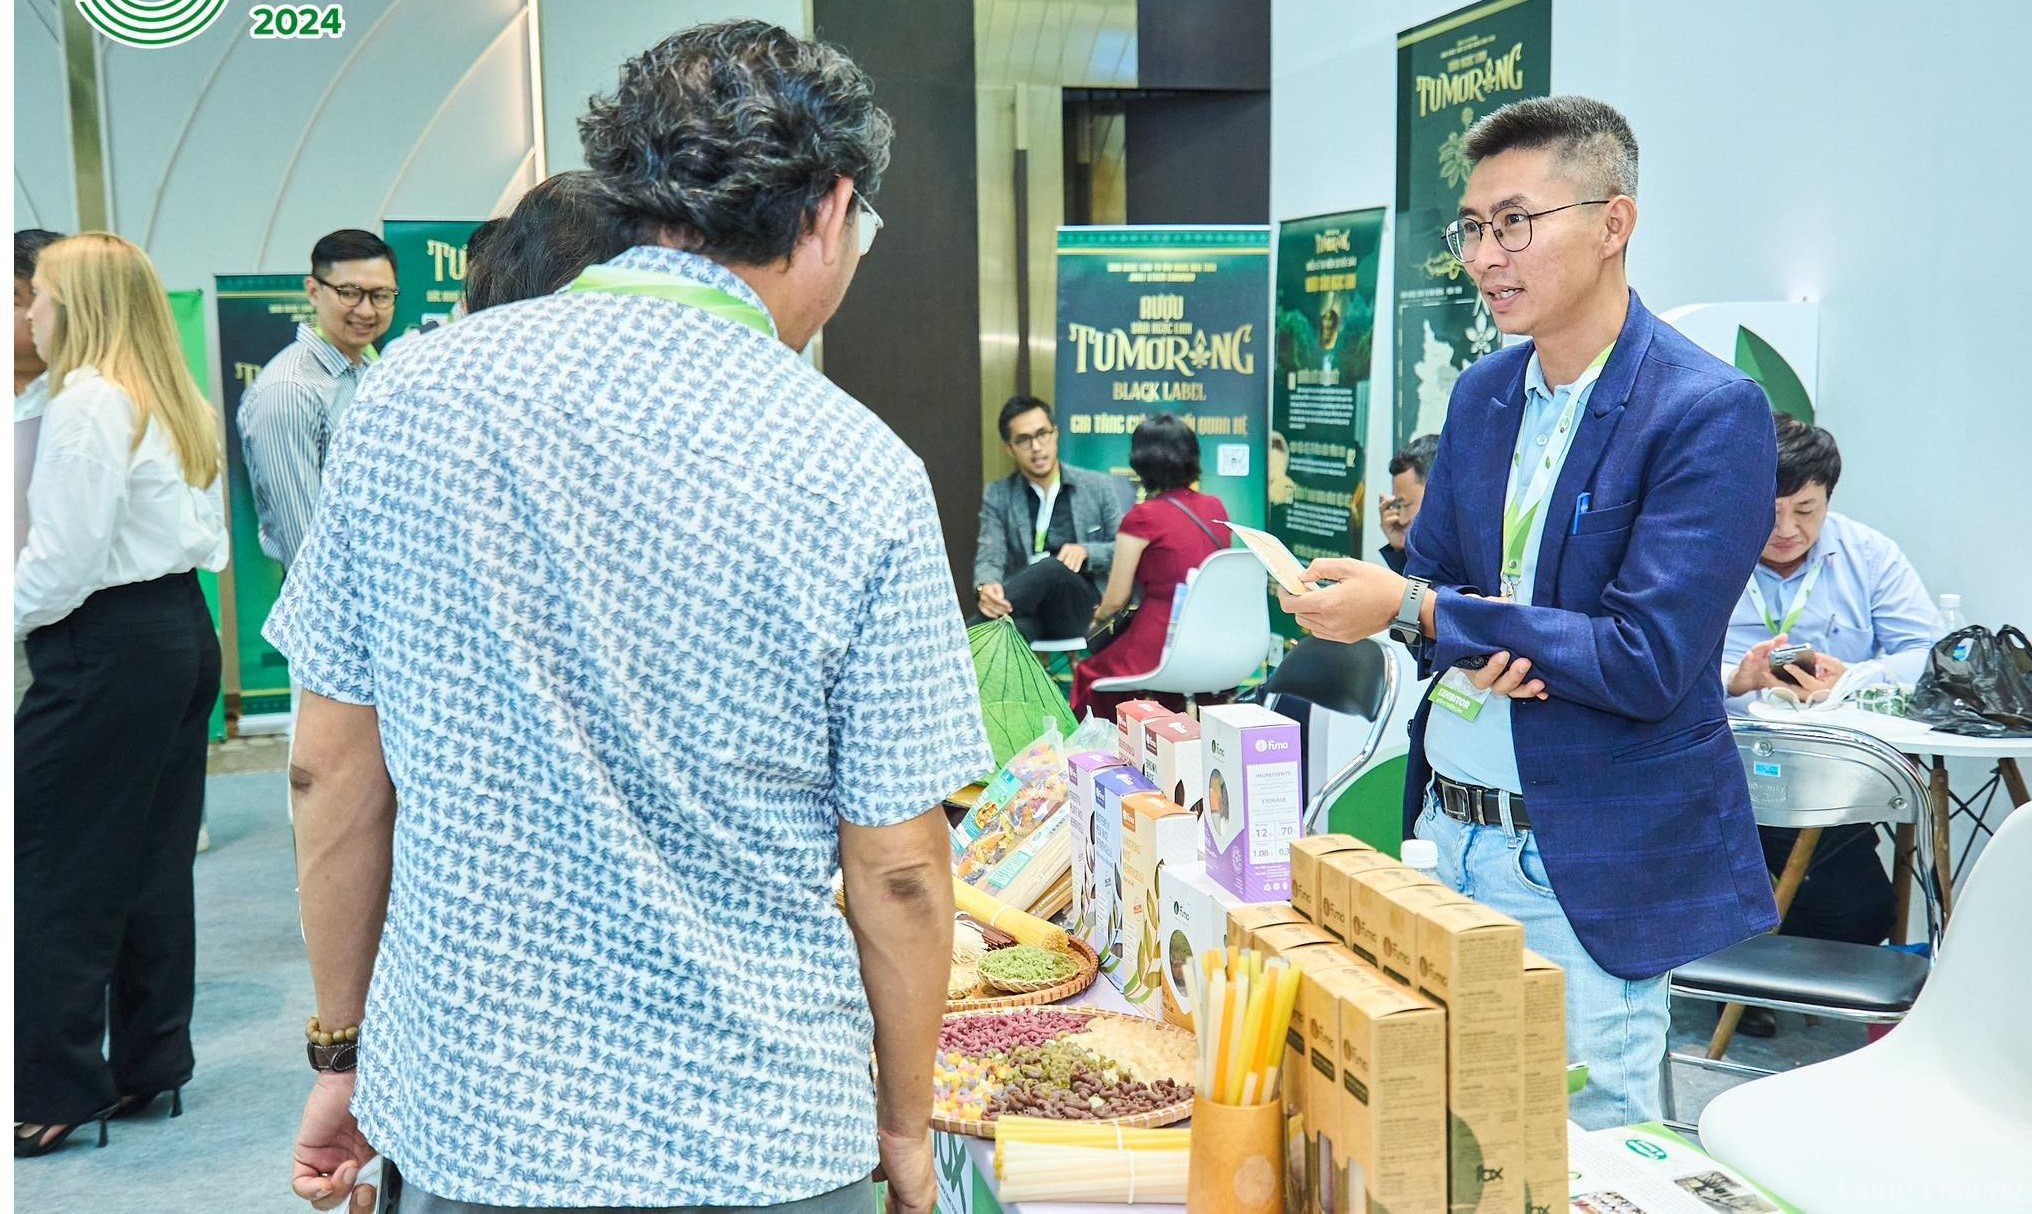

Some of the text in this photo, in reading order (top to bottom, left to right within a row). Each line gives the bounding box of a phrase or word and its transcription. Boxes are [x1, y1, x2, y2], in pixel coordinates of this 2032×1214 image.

[1112, 381, 1207, 402] BLACK LABEL
[1256, 827, 1293, 838] 12 70
